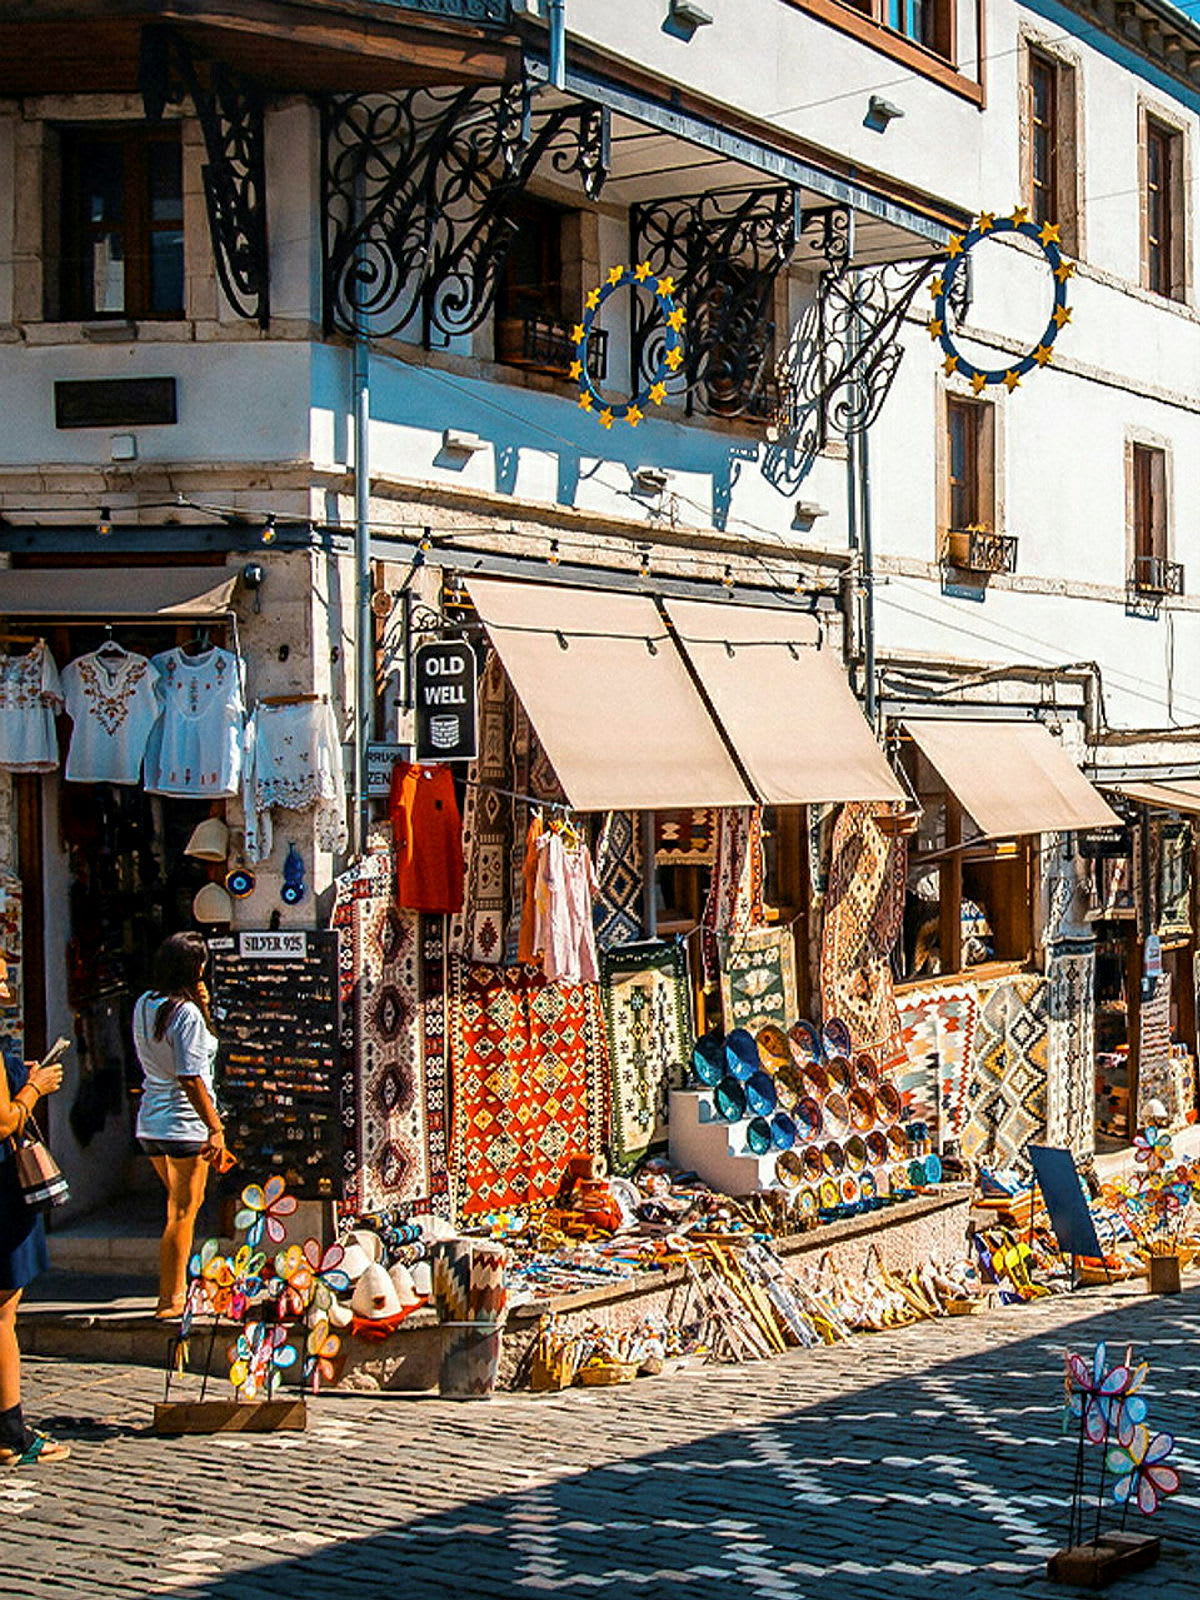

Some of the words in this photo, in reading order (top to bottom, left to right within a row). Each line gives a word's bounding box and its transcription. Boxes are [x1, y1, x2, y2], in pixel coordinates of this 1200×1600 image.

[425, 656, 465, 676] OLD
[424, 686, 467, 705] WELL
[243, 936, 282, 951] SILVER
[283, 936, 303, 951] 925
